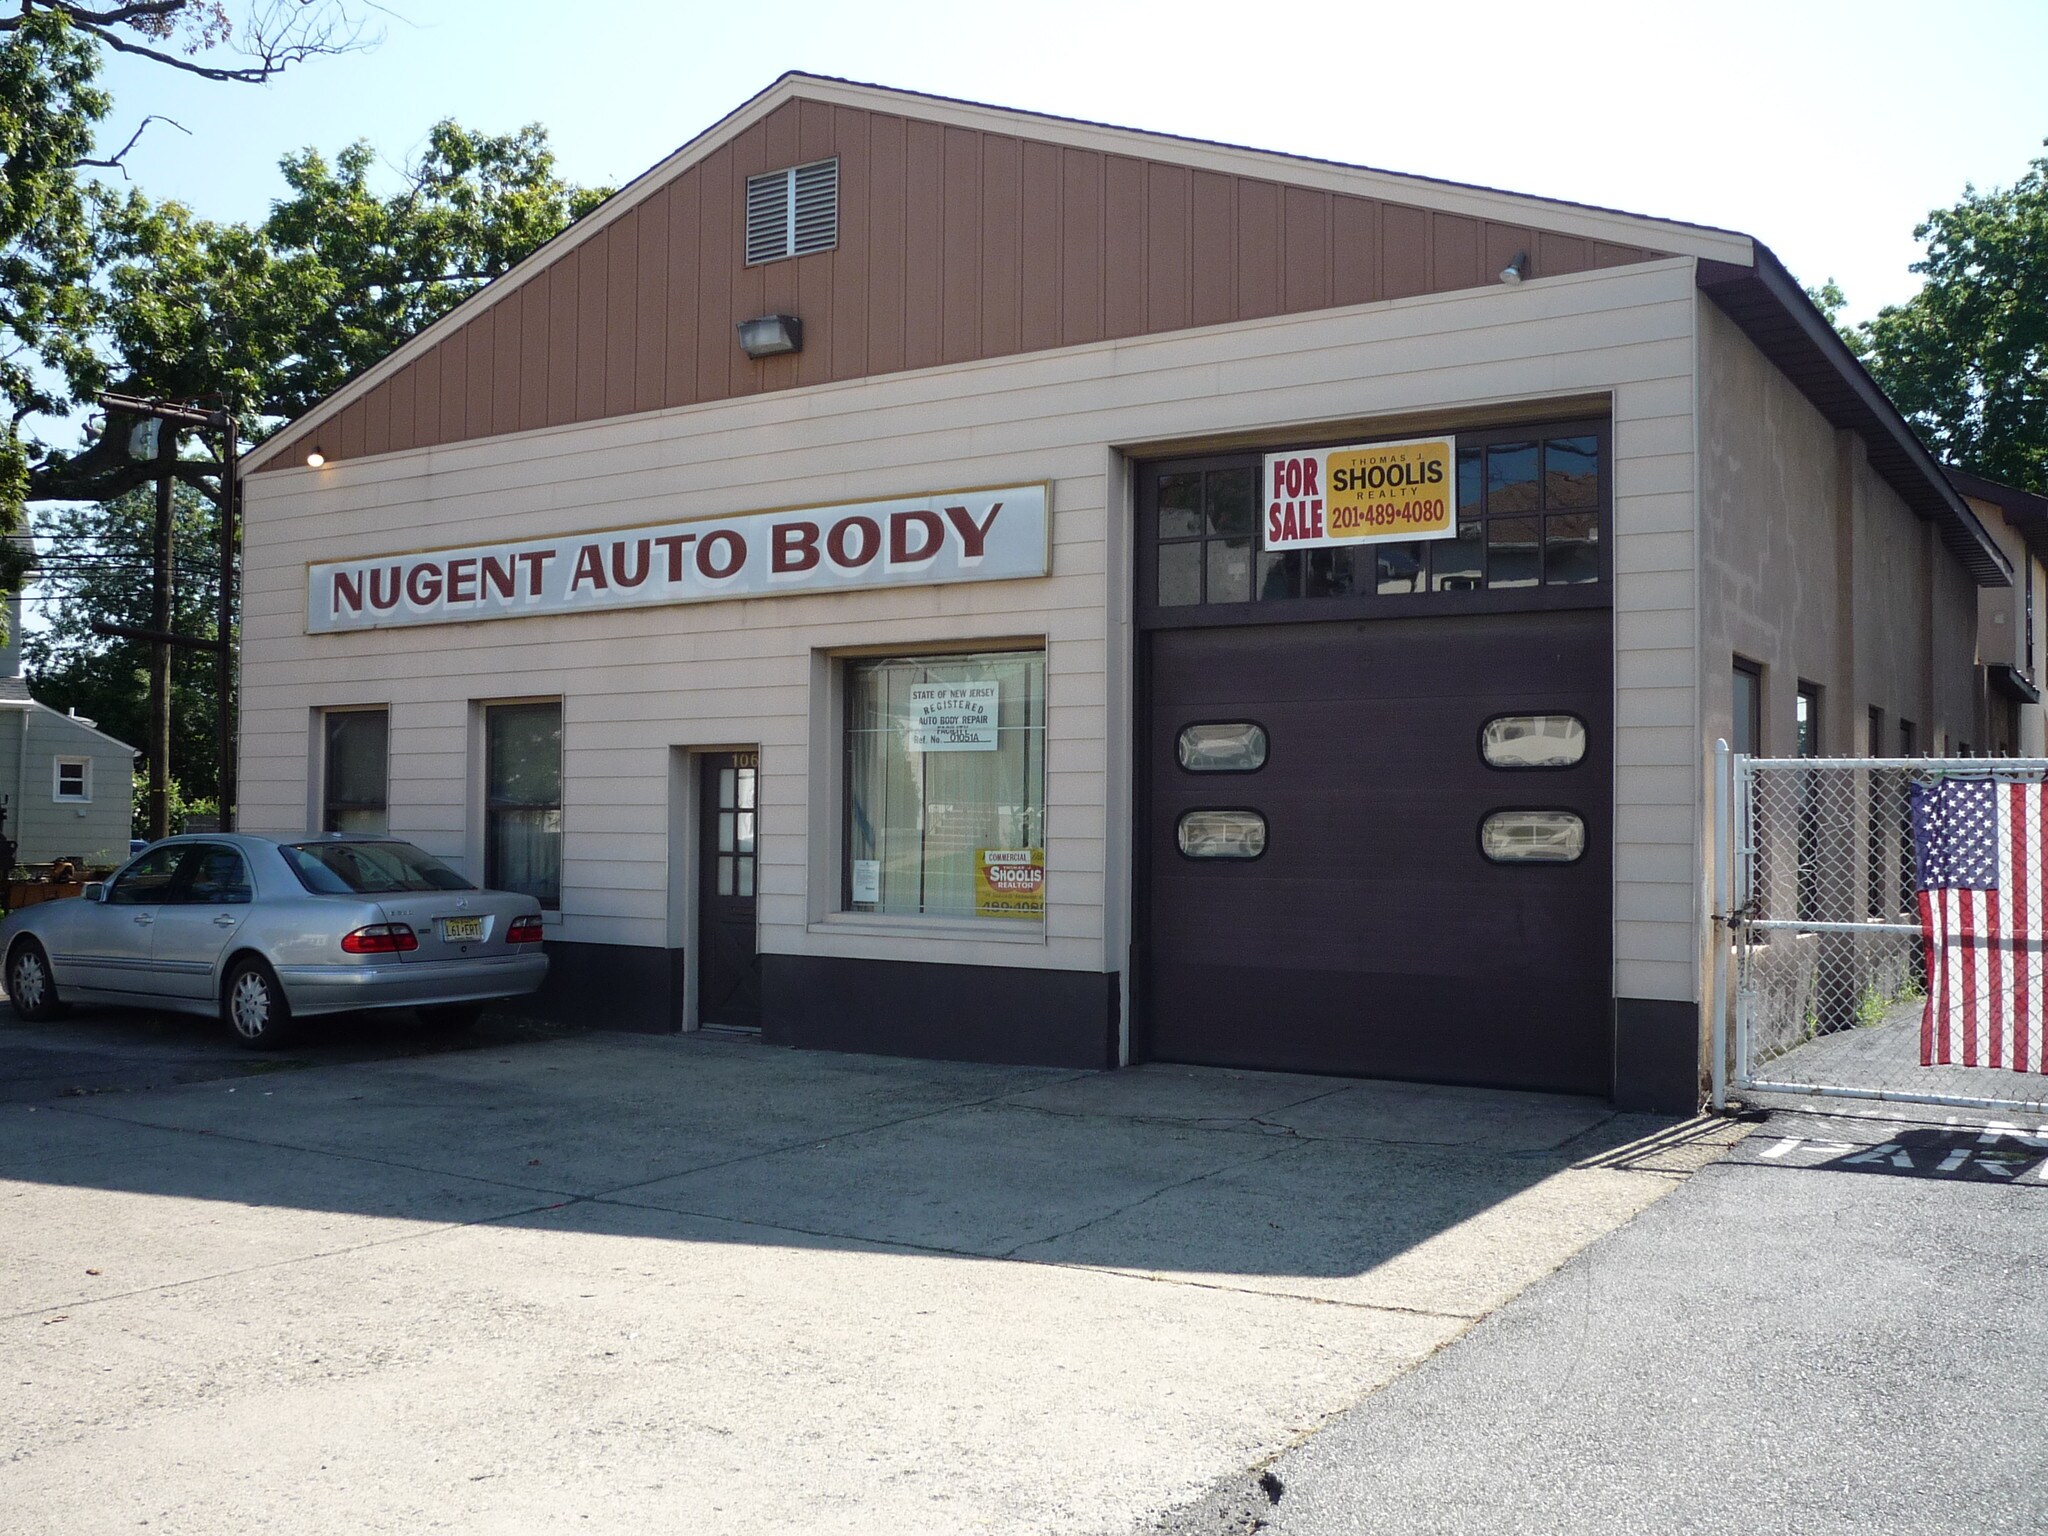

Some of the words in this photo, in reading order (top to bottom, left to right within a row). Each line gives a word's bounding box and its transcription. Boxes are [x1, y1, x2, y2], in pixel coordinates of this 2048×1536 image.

[1352, 454, 1406, 466] THOMAS
[1274, 457, 1319, 499] FOR
[1333, 460, 1444, 492] SHOOLIS
[1357, 487, 1419, 500] REALTY
[1269, 499, 1323, 543] SALE
[333, 550, 557, 617] NUGENT
[568, 529, 748, 596] AUTO
[769, 502, 1004, 576] BODY
[913, 690, 935, 700] STATE
[937, 689, 947, 699] OF
[950, 689, 967, 698] NEW
[969, 687, 995, 698] JERSEY
[923, 700, 984, 715] REGISTERED
[919, 716, 938, 725] AUTO
[940, 715, 959, 725] BODY
[962, 715, 988, 724] REPAIR
[930, 735, 943, 744] No.
[732, 753, 759, 768] 106
[989, 853, 1027, 861] COMMERCIAL
[990, 866, 1042, 882] SHOOLIS
